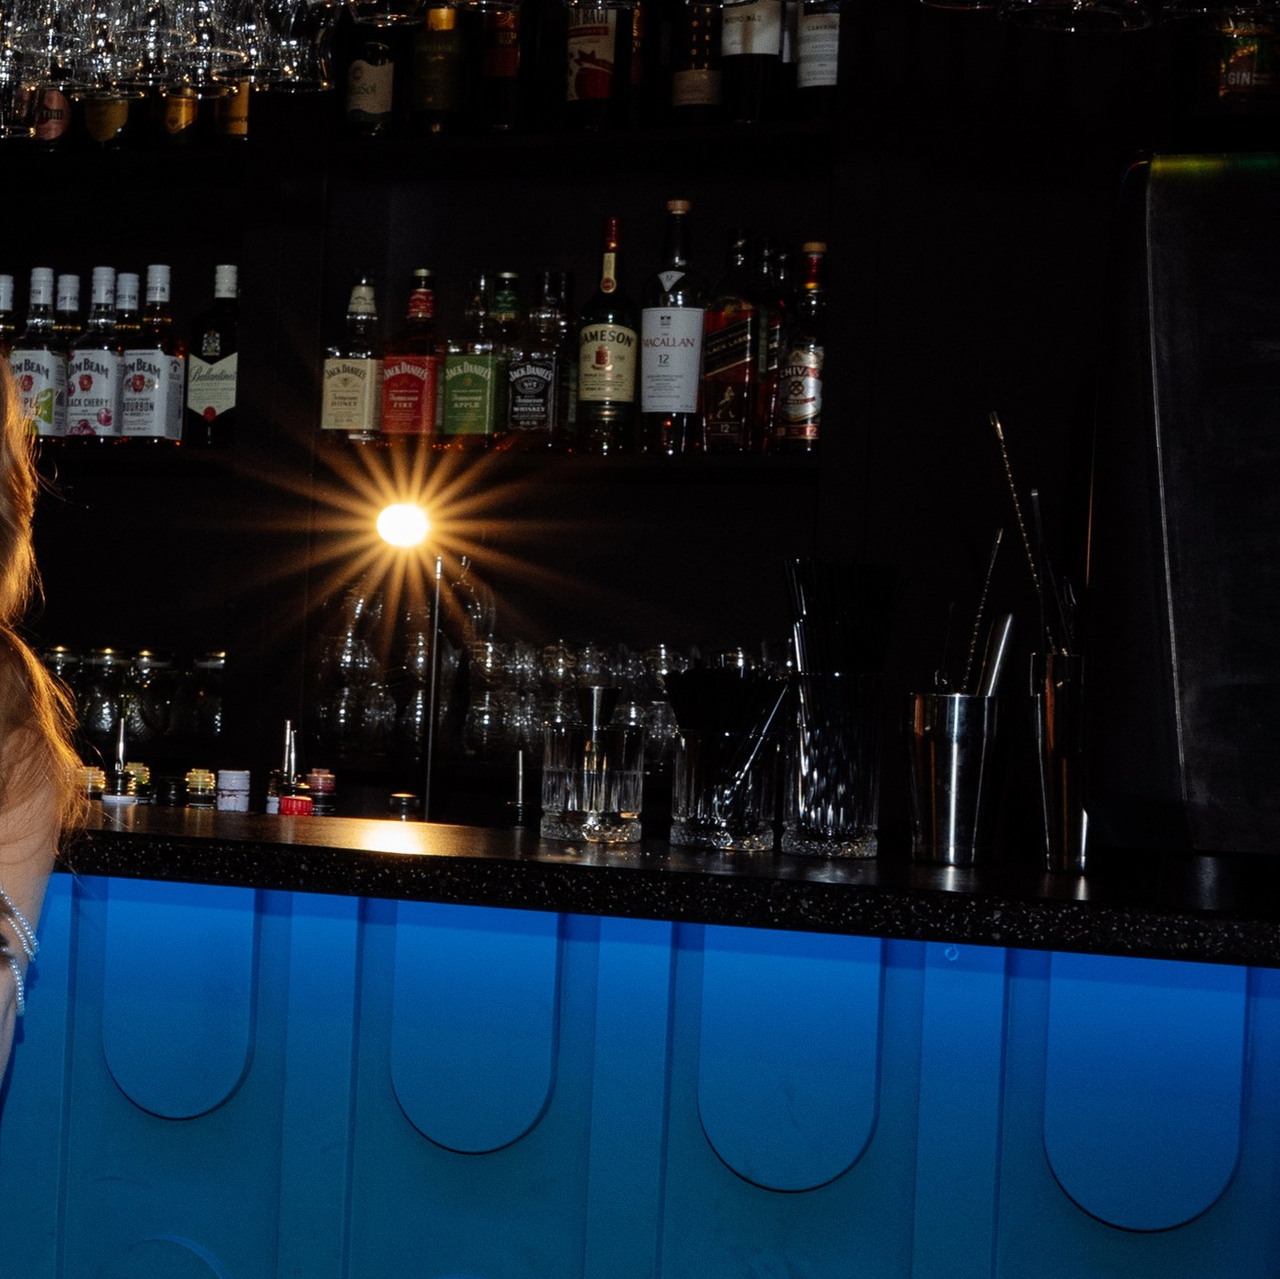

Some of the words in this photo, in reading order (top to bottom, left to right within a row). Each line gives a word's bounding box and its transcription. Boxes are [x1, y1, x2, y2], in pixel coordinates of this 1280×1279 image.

[658, 354, 669, 364] 12
[508, 367, 526, 383] JACK
[720, 424, 730, 433] 12
